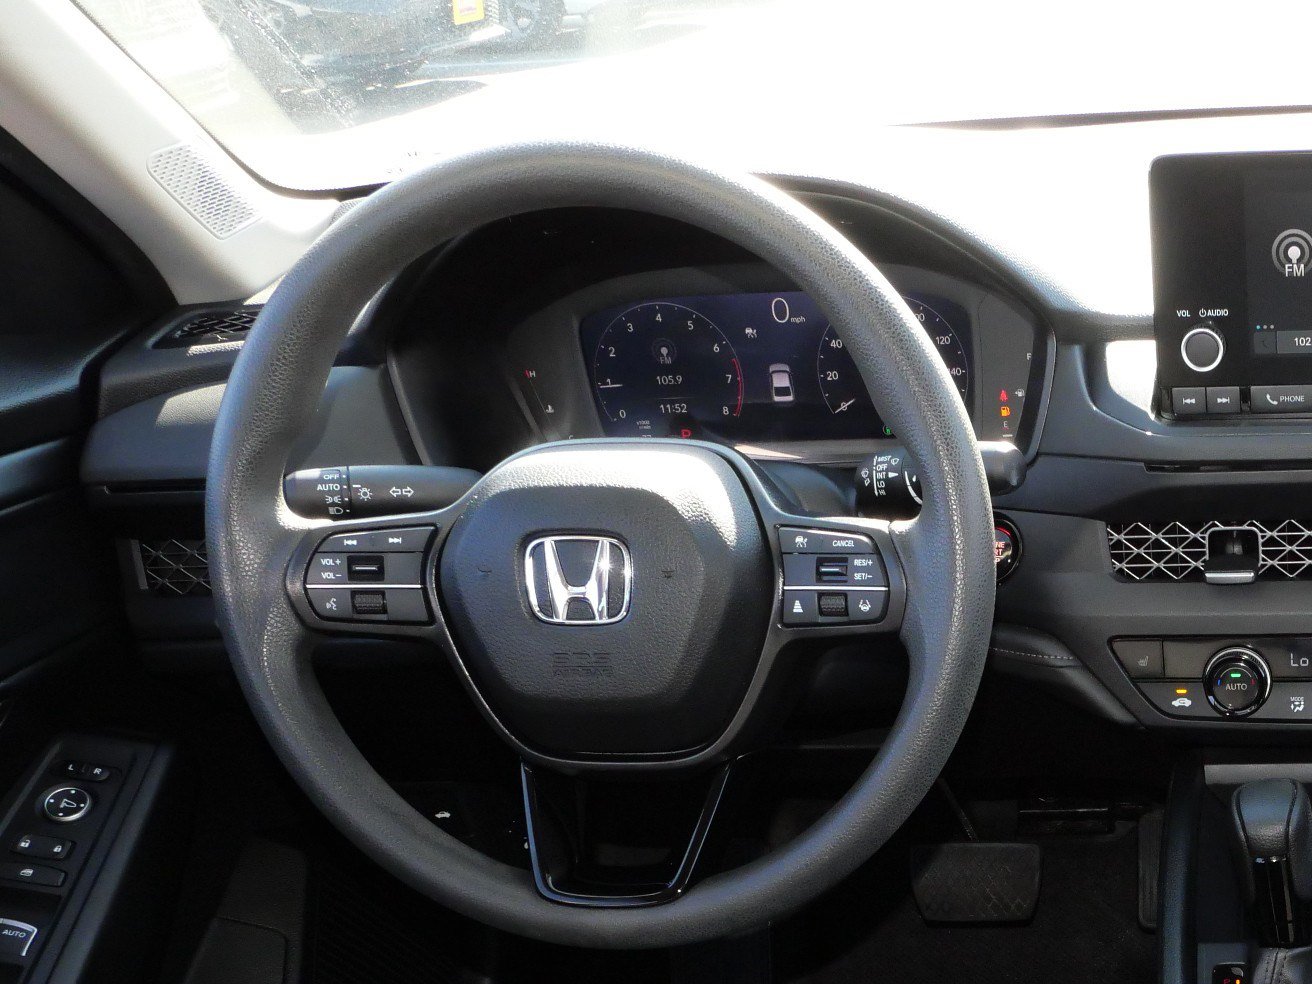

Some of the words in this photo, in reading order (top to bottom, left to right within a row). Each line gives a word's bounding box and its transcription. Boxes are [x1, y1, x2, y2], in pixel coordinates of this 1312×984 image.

[1285, 264, 1305, 277] FM
[1176, 309, 1191, 318] VOL
[1207, 308, 1229, 317] AUDIO
[627, 323, 634, 332] 3
[687, 320, 694, 330] 5
[830, 339, 843, 349] 40
[935, 336, 950, 345] 120
[608, 347, 616, 357] 2
[713, 343, 720, 353] 6
[656, 375, 682, 385] 105.9
[826, 371, 839, 381] 20
[1279, 394, 1305, 403] PHONE
[659, 403, 688, 413] 11:52
[876, 463, 888, 471] OFF
[317, 483, 341, 491] AUTO
[2, 929, 26, 938] AUTO
